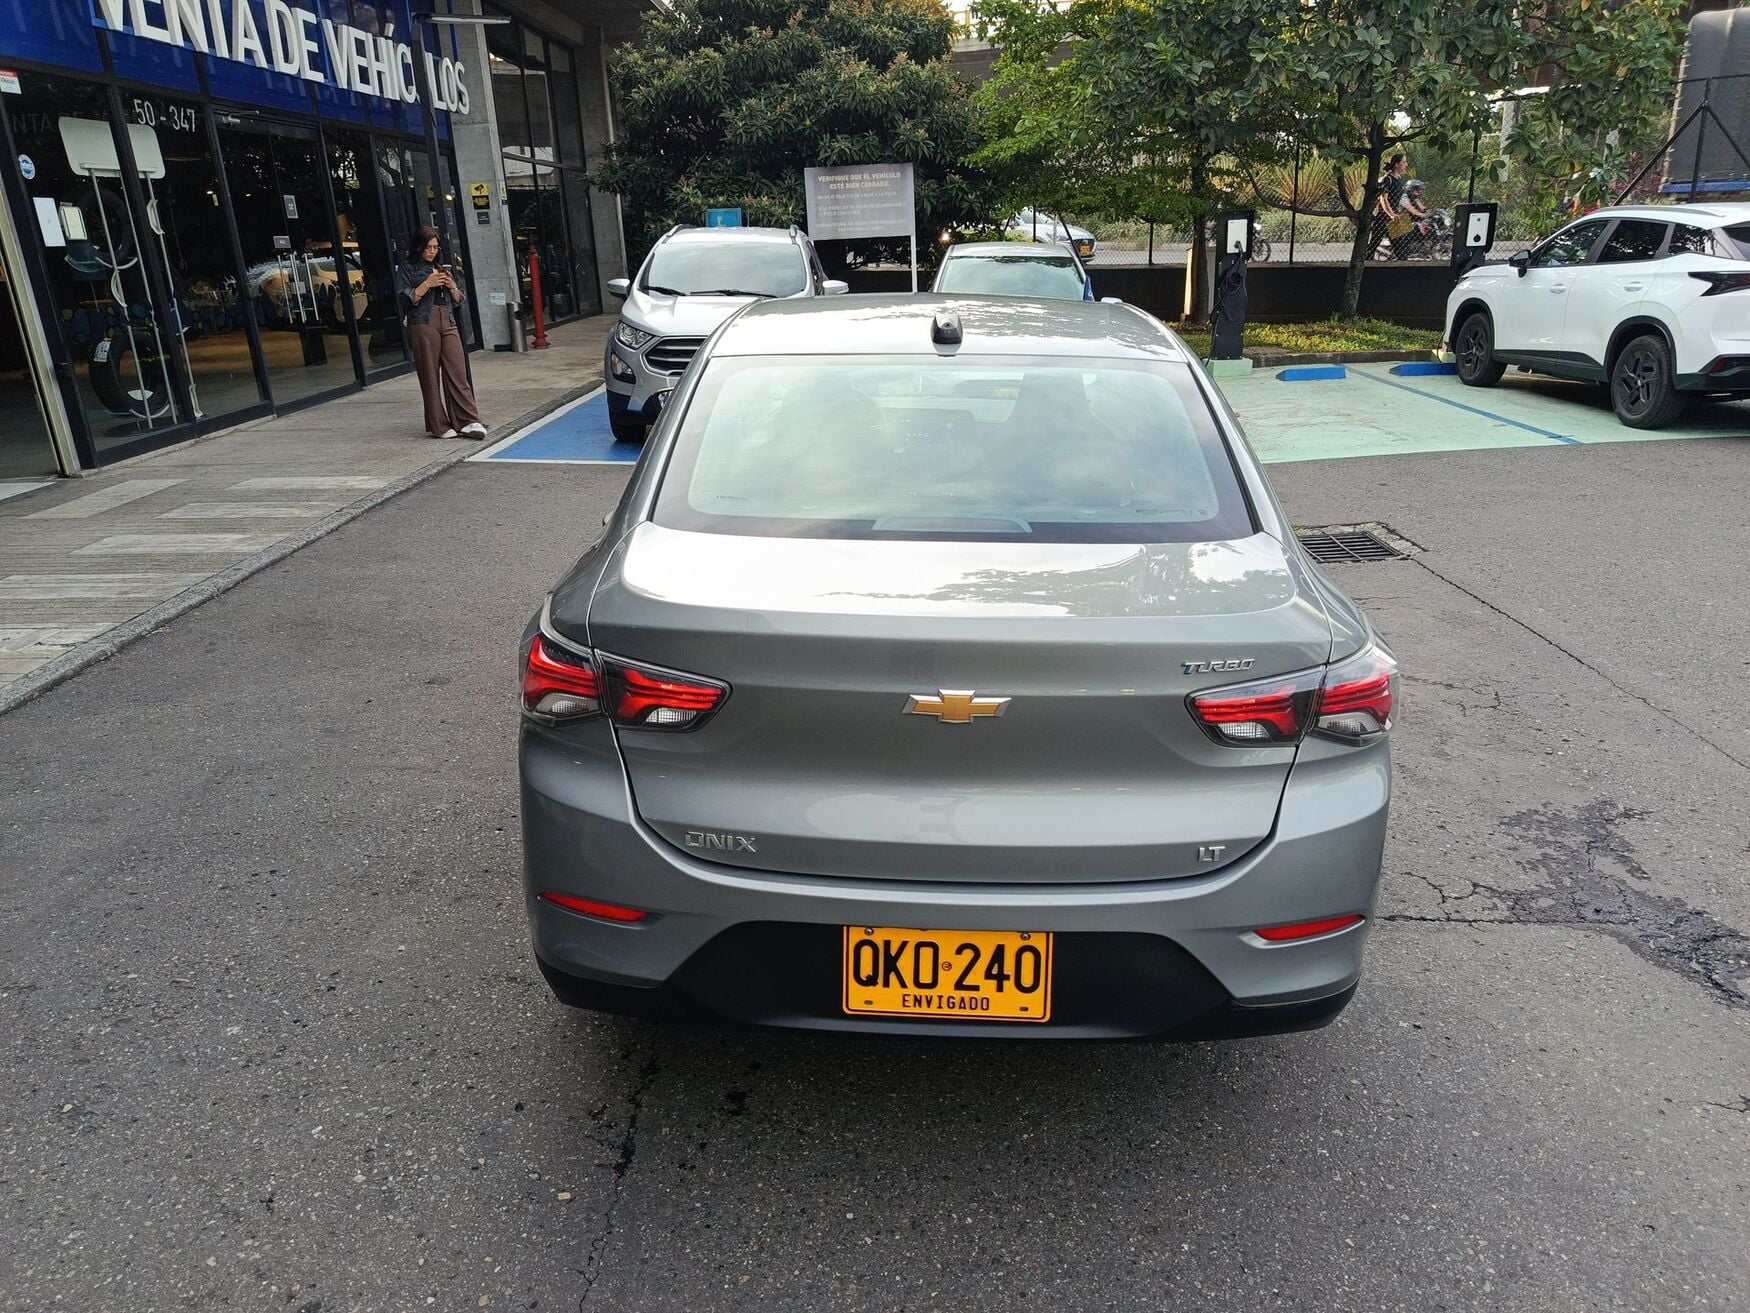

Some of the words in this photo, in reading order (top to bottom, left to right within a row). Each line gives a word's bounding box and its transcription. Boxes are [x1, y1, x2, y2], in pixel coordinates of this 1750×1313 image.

[263, 0, 325, 84] DE
[321, 18, 471, 115] VEHÍCLOS
[134, 99, 155, 126] 50
[169, 105, 195, 132] 347
[817, 174, 849, 182] VERIFIQUE
[850, 173, 862, 181] QUE
[872, 171, 901, 179] VEHÍCULO
[1181, 658, 1256, 675] TURBO
[685, 831, 757, 853] ONIX
[1197, 845, 1226, 862] LT
[853, 938, 939, 989] QKO
[953, 943, 1042, 994] 240
[902, 993, 990, 1011] ENVIGADO
